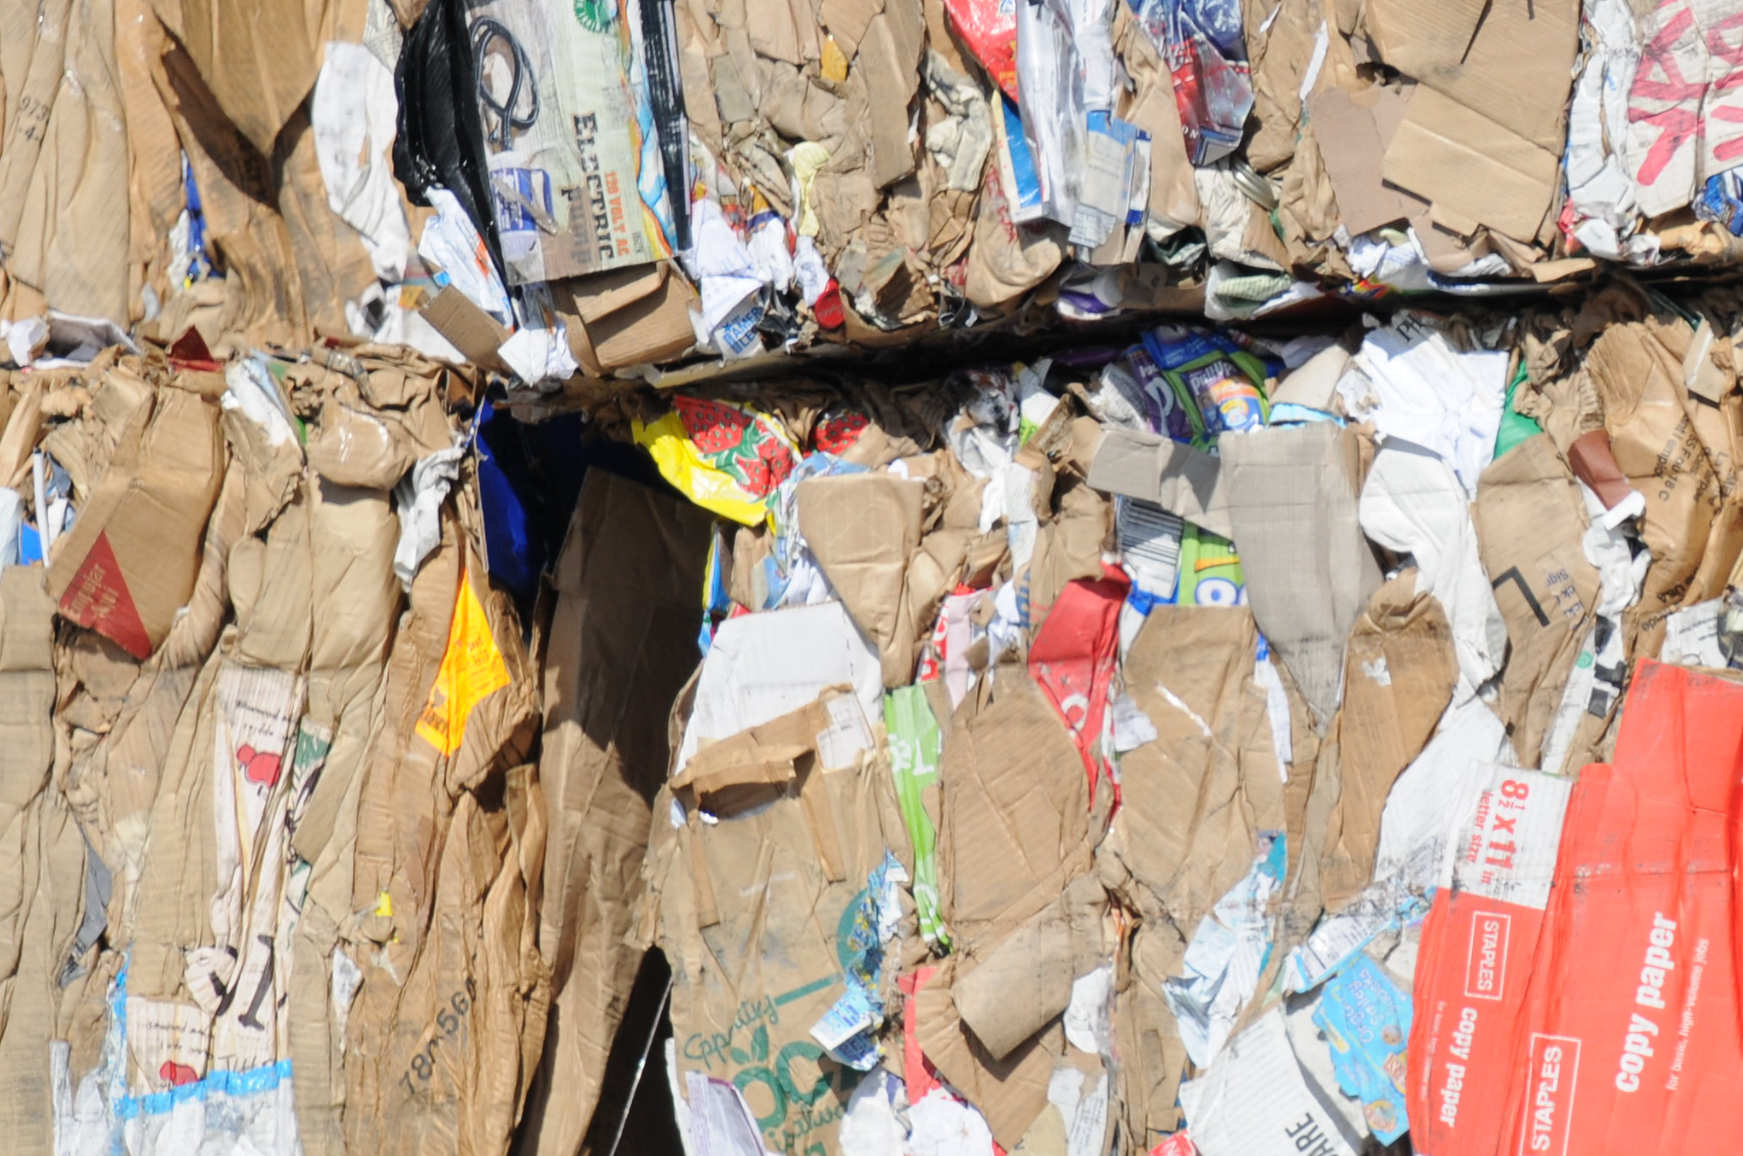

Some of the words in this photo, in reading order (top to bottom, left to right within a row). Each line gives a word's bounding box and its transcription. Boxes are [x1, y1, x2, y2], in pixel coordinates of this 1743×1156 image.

[574, 112, 615, 260] ELECTRIC
[605, 171, 620, 195] 120
[610, 197, 627, 233] VOLT
[616, 238, 631, 257] AC
[1475, 791, 1493, 830] letter
[1466, 832, 1484, 864] size
[1485, 840, 1517, 871] 11
[1482, 870, 1492, 885] in
[1478, 920, 1499, 992] STAPLES
[1635, 912, 1677, 1010] paper
[1693, 938, 1709, 964] jobs
[1680, 964, 1704, 1037] high-volume
[1450, 1007, 1477, 1061] copy
[1615, 1013, 1659, 1094] copy
[1671, 1036, 1690, 1071] basic,
[1440, 1062, 1466, 1128] paper
[1532, 1045, 1562, 1151] STAPLES
[1666, 1073, 1679, 1090] for
